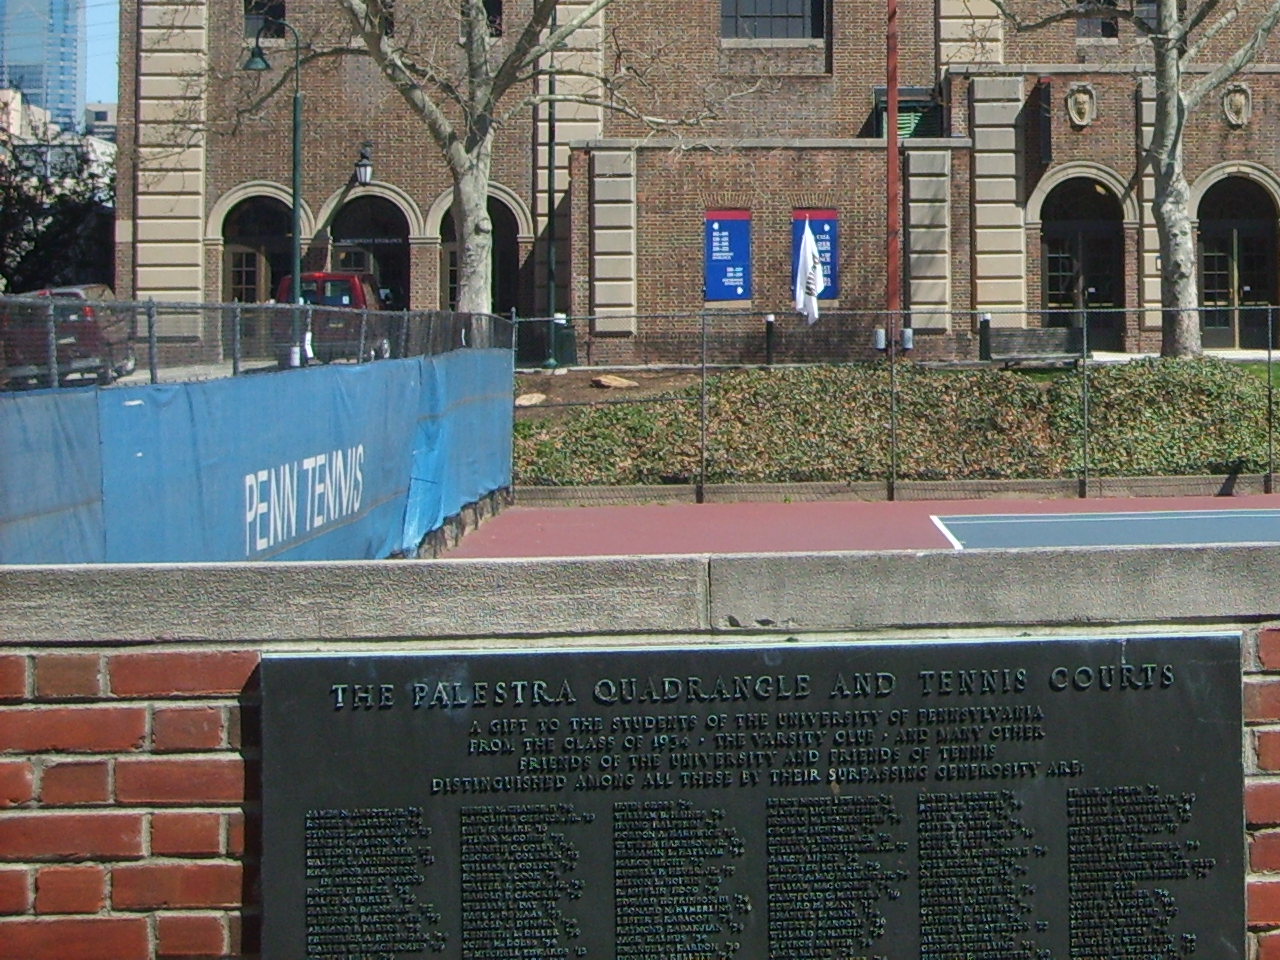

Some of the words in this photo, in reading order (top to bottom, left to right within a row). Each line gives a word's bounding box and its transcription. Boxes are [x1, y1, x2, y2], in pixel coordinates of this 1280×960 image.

[245, 461, 297, 556] PENN
[303, 444, 364, 531] TENNIS
[332, 683, 396, 708] THE
[412, 679, 577, 708] PALESTRA
[593, 674, 811, 704] QUADRANGLE
[830, 671, 897, 697] AND
[919, 668, 1028, 695] TENNIS
[1050, 663, 1176, 690] COURTS
[469, 720, 482, 733] A
[490, 718, 528, 733] GIFT
[537, 718, 560, 732] TO
[569, 716, 603, 731] THE
[611, 714, 698, 730] STUDENTS
[706, 713, 728, 728] OF
[735, 712, 769, 727] THE
[778, 709, 883, 727] UNIVERSITY
[888, 709, 910, 723] OF
[918, 704, 1044, 723] PENNSYLVANIA
[469, 738, 515, 753] FROM
[522, 737, 555, 752] THE
[564, 736, 616, 750] CLASS
[624, 735, 644, 749] OF
[715, 732, 746, 747] THE
[752, 730, 827, 746] VARSITY
[896, 727, 930, 742] AND
[936, 725, 984, 740] MANY
[991, 724, 1046, 739] OTHER
[520, 754, 592, 771] FRIENDS
[600, 754, 621, 768] OF
[628, 753, 661, 768] THE
[671, 751, 778, 767] UNIVERSITY
[785, 749, 819, 764] AND
[828, 747, 901, 763] FRIENDS
[909, 746, 931, 760] OF
[939, 744, 997, 760] TENNIS
[432, 775, 568, 792] DISTINGUISHED
[575, 773, 636, 789] AMONG
[643, 772, 674, 787] ALL
[680, 770, 733, 786] THESE
[741, 769, 762, 784] BY
[770, 767, 821, 784] THEIR
[828, 764, 929, 782] SURPASSING
[937, 761, 1043, 781] GENEROSITY
